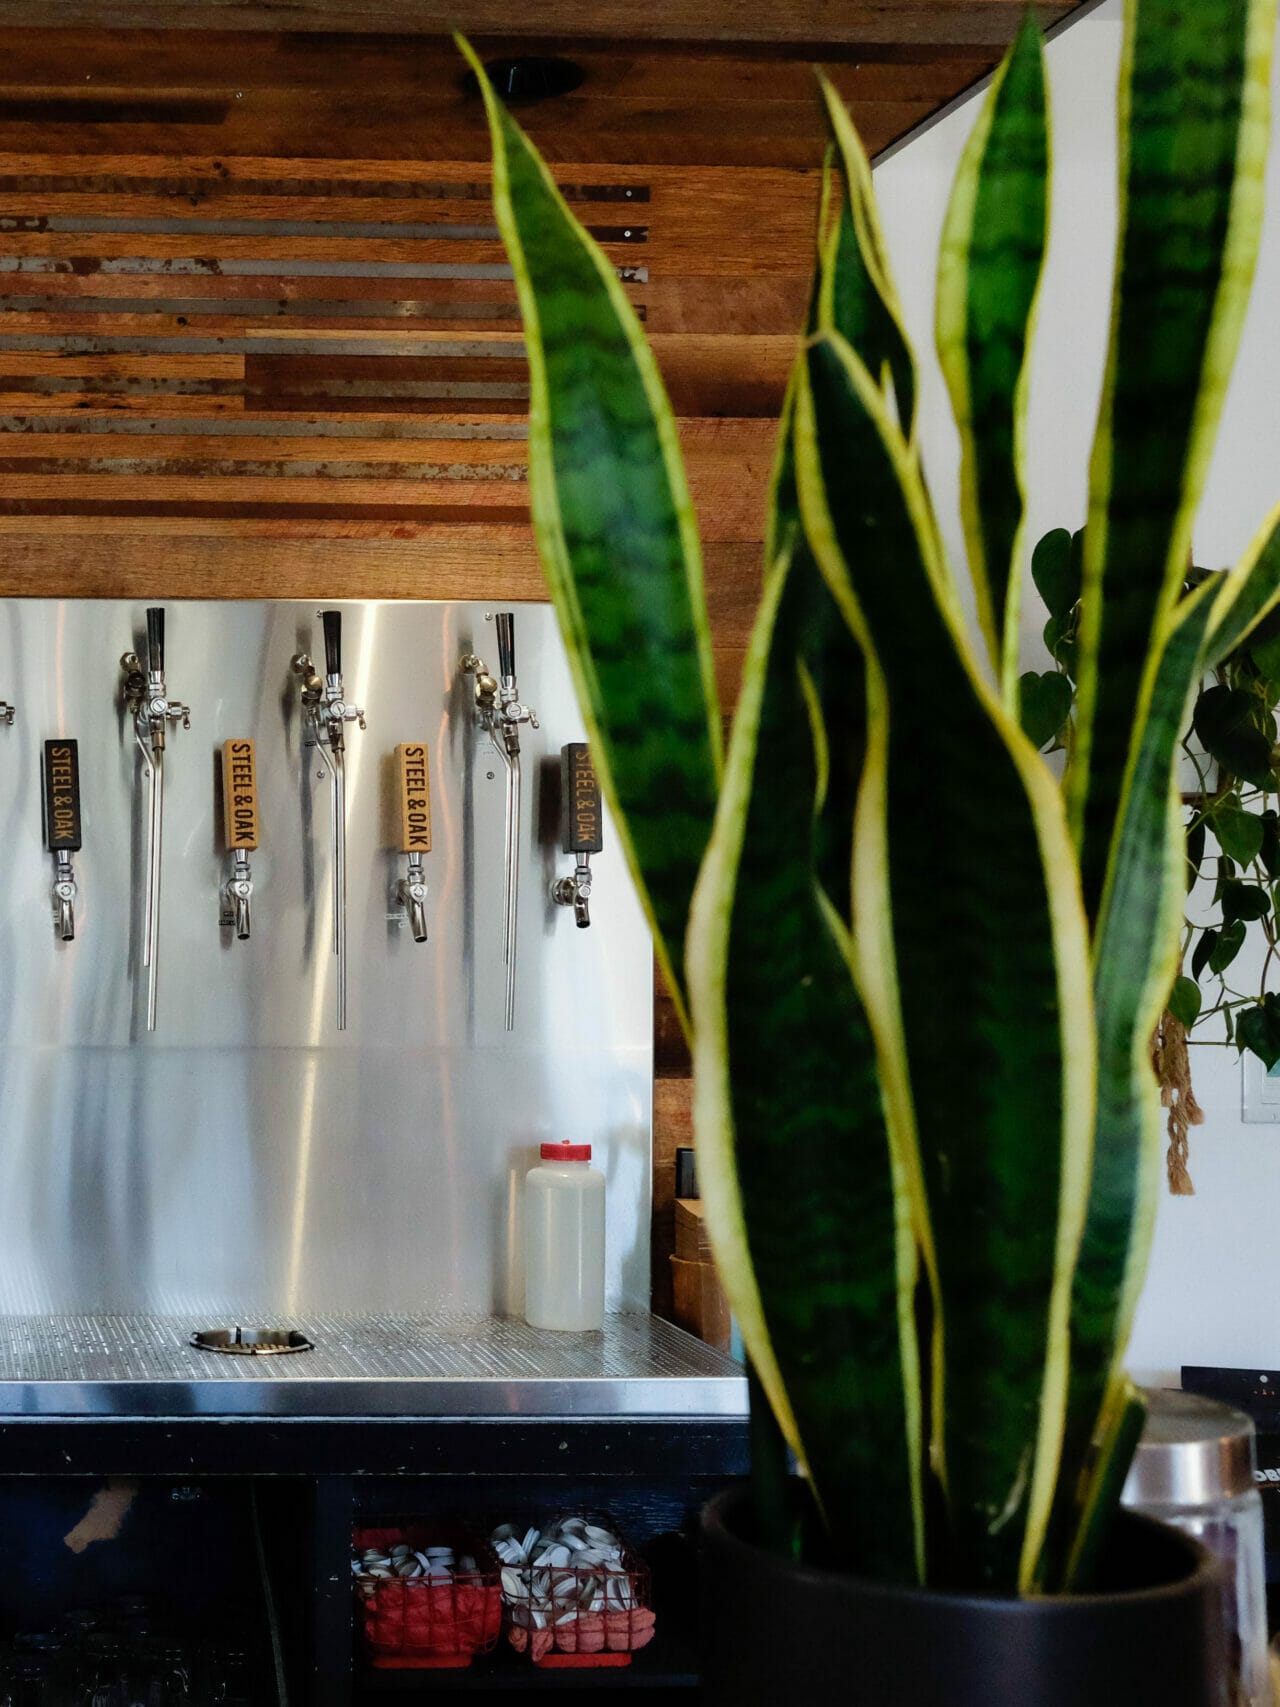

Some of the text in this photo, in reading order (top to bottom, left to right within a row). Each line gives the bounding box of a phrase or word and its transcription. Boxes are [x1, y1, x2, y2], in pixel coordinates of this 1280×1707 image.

[51, 747, 74, 840] STEEL & OAK
[231, 743, 254, 842] STEEL & OAK
[405, 747, 428, 846] STEEL & OAK
[576, 799, 595, 810] &
[577, 812, 596, 843] OAK
